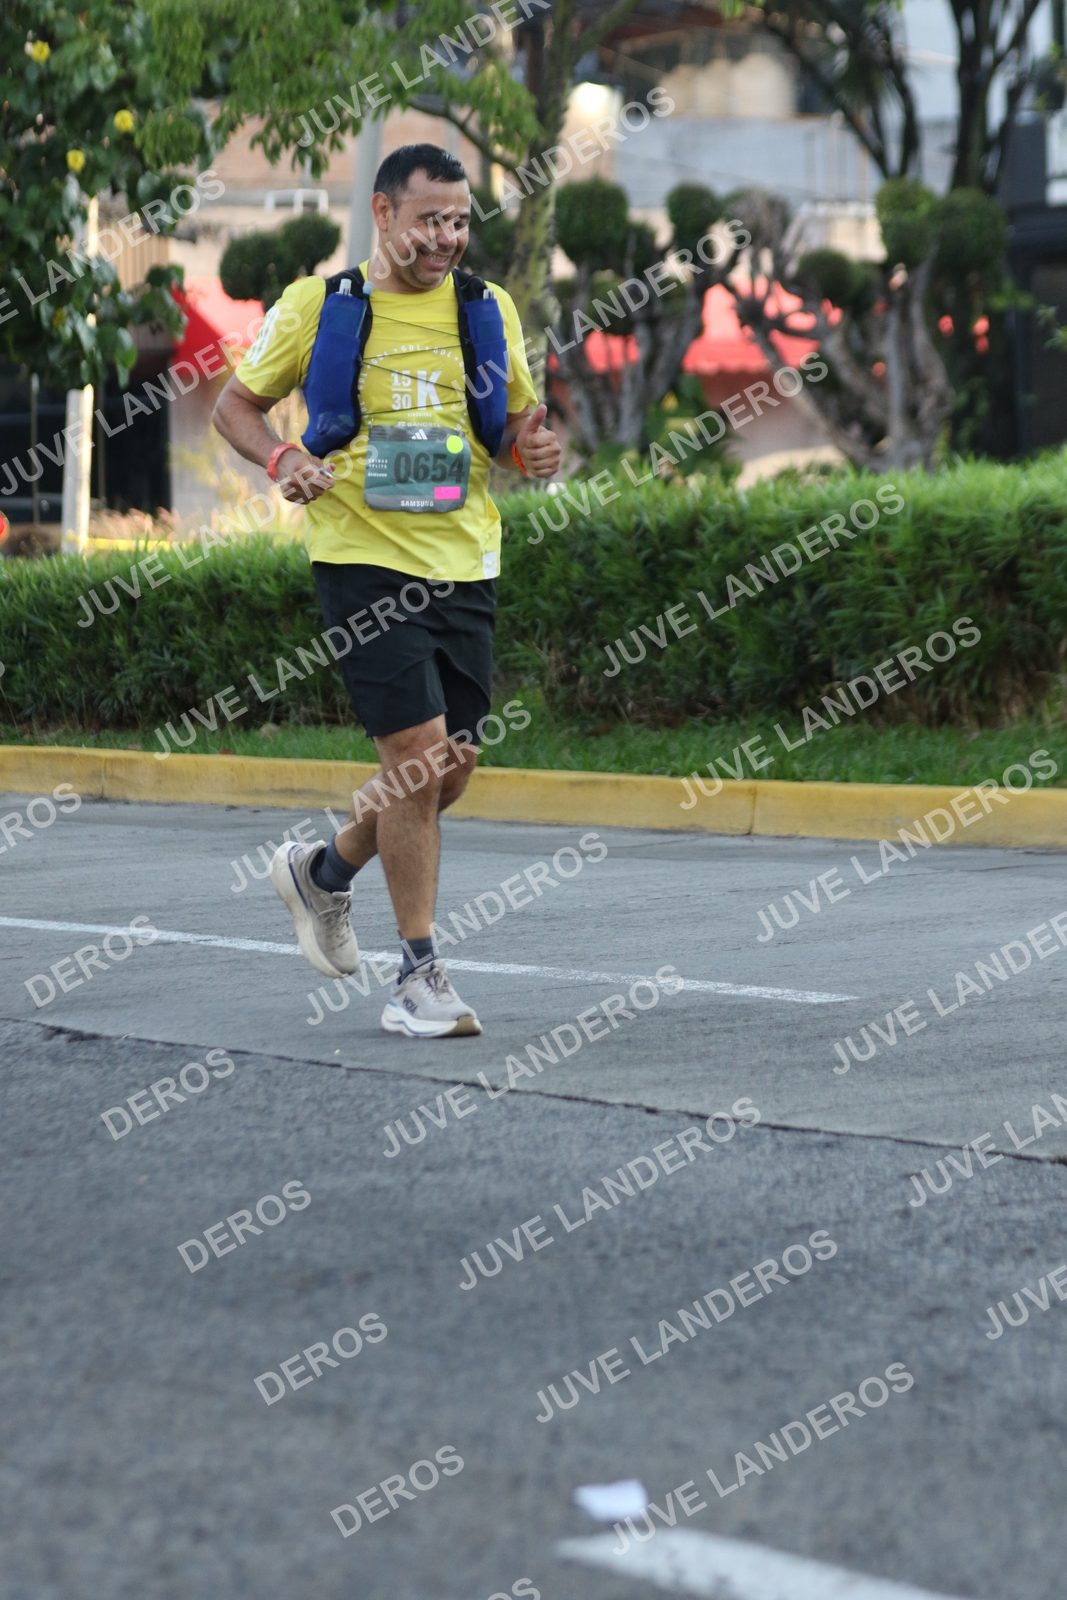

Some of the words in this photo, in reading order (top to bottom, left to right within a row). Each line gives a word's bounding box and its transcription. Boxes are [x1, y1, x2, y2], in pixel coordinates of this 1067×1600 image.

[401, 344, 421, 352] GDL
[391, 369, 412, 387] 15
[417, 370, 444, 411] K
[391, 394, 412, 411] 30
[393, 451, 465, 485] 0654
